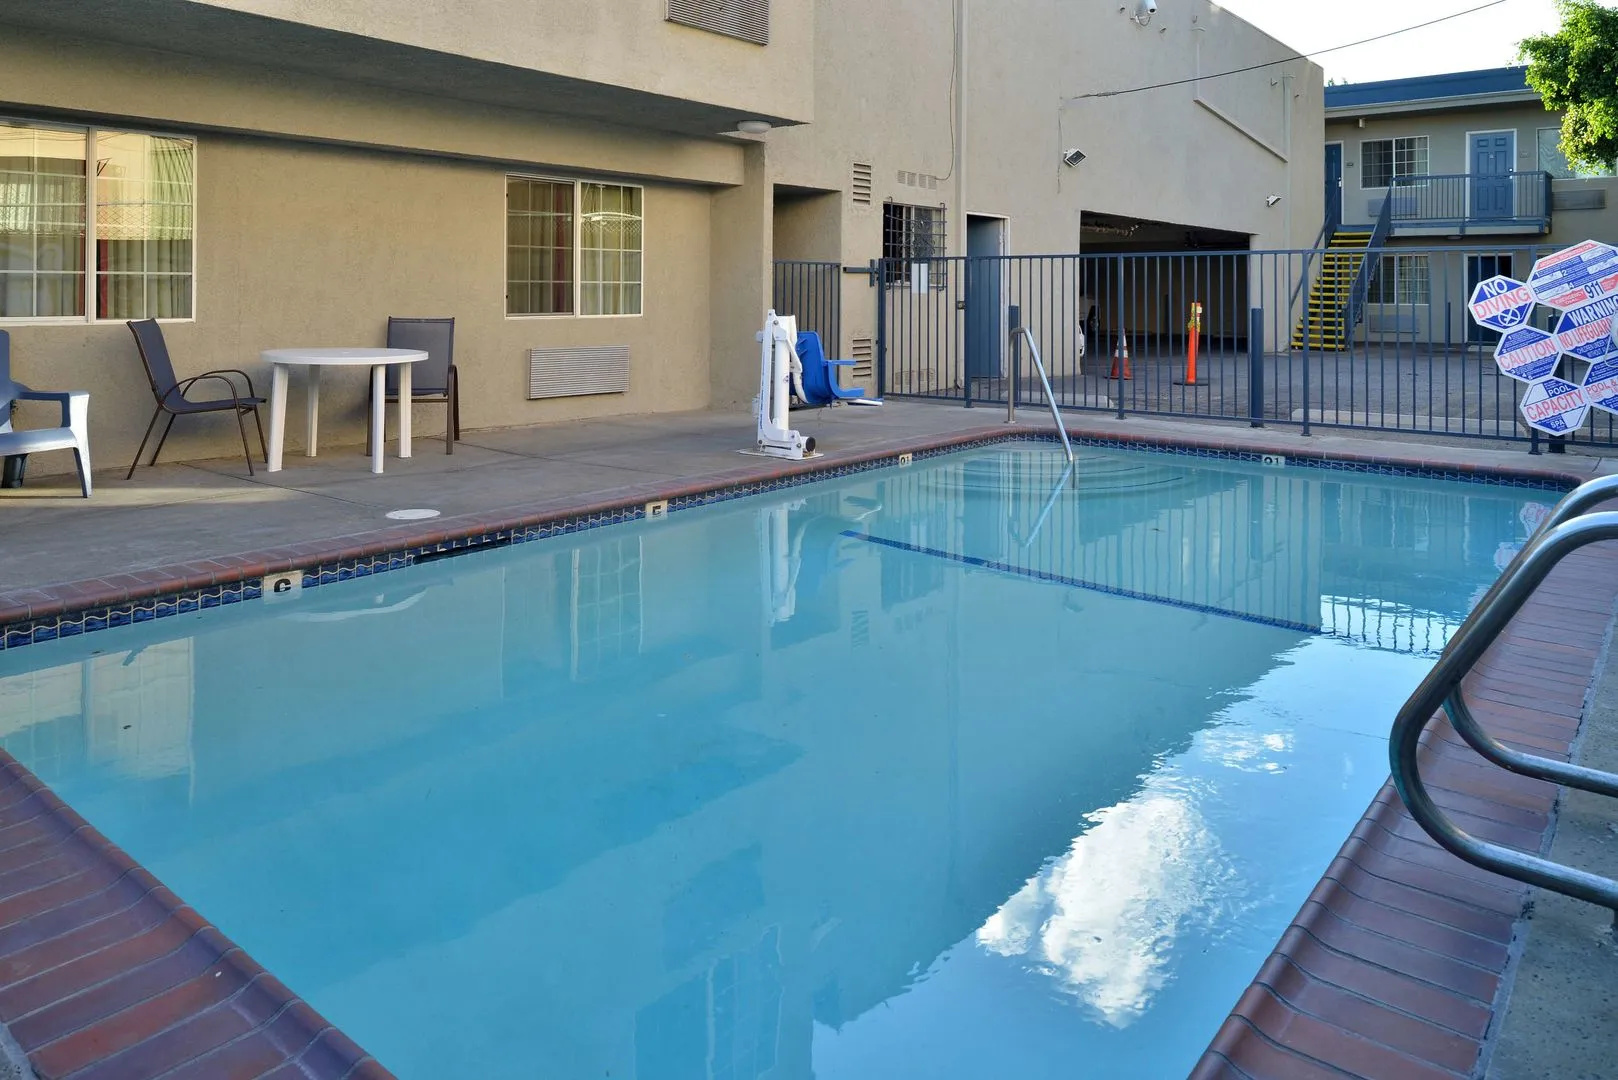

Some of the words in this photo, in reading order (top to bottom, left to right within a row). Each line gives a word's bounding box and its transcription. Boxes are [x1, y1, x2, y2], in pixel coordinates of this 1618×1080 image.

[1482, 279, 1508, 299] NO
[1584, 280, 1604, 299] 911
[1473, 287, 1532, 319] DIVING
[1557, 332, 1573, 349] NO
[1500, 338, 1557, 369] CAUTION
[1548, 384, 1571, 397] POOL
[1585, 381, 1610, 395] POOL
[1526, 389, 1585, 420] CAPACITY
[1550, 420, 1565, 429] SPA
